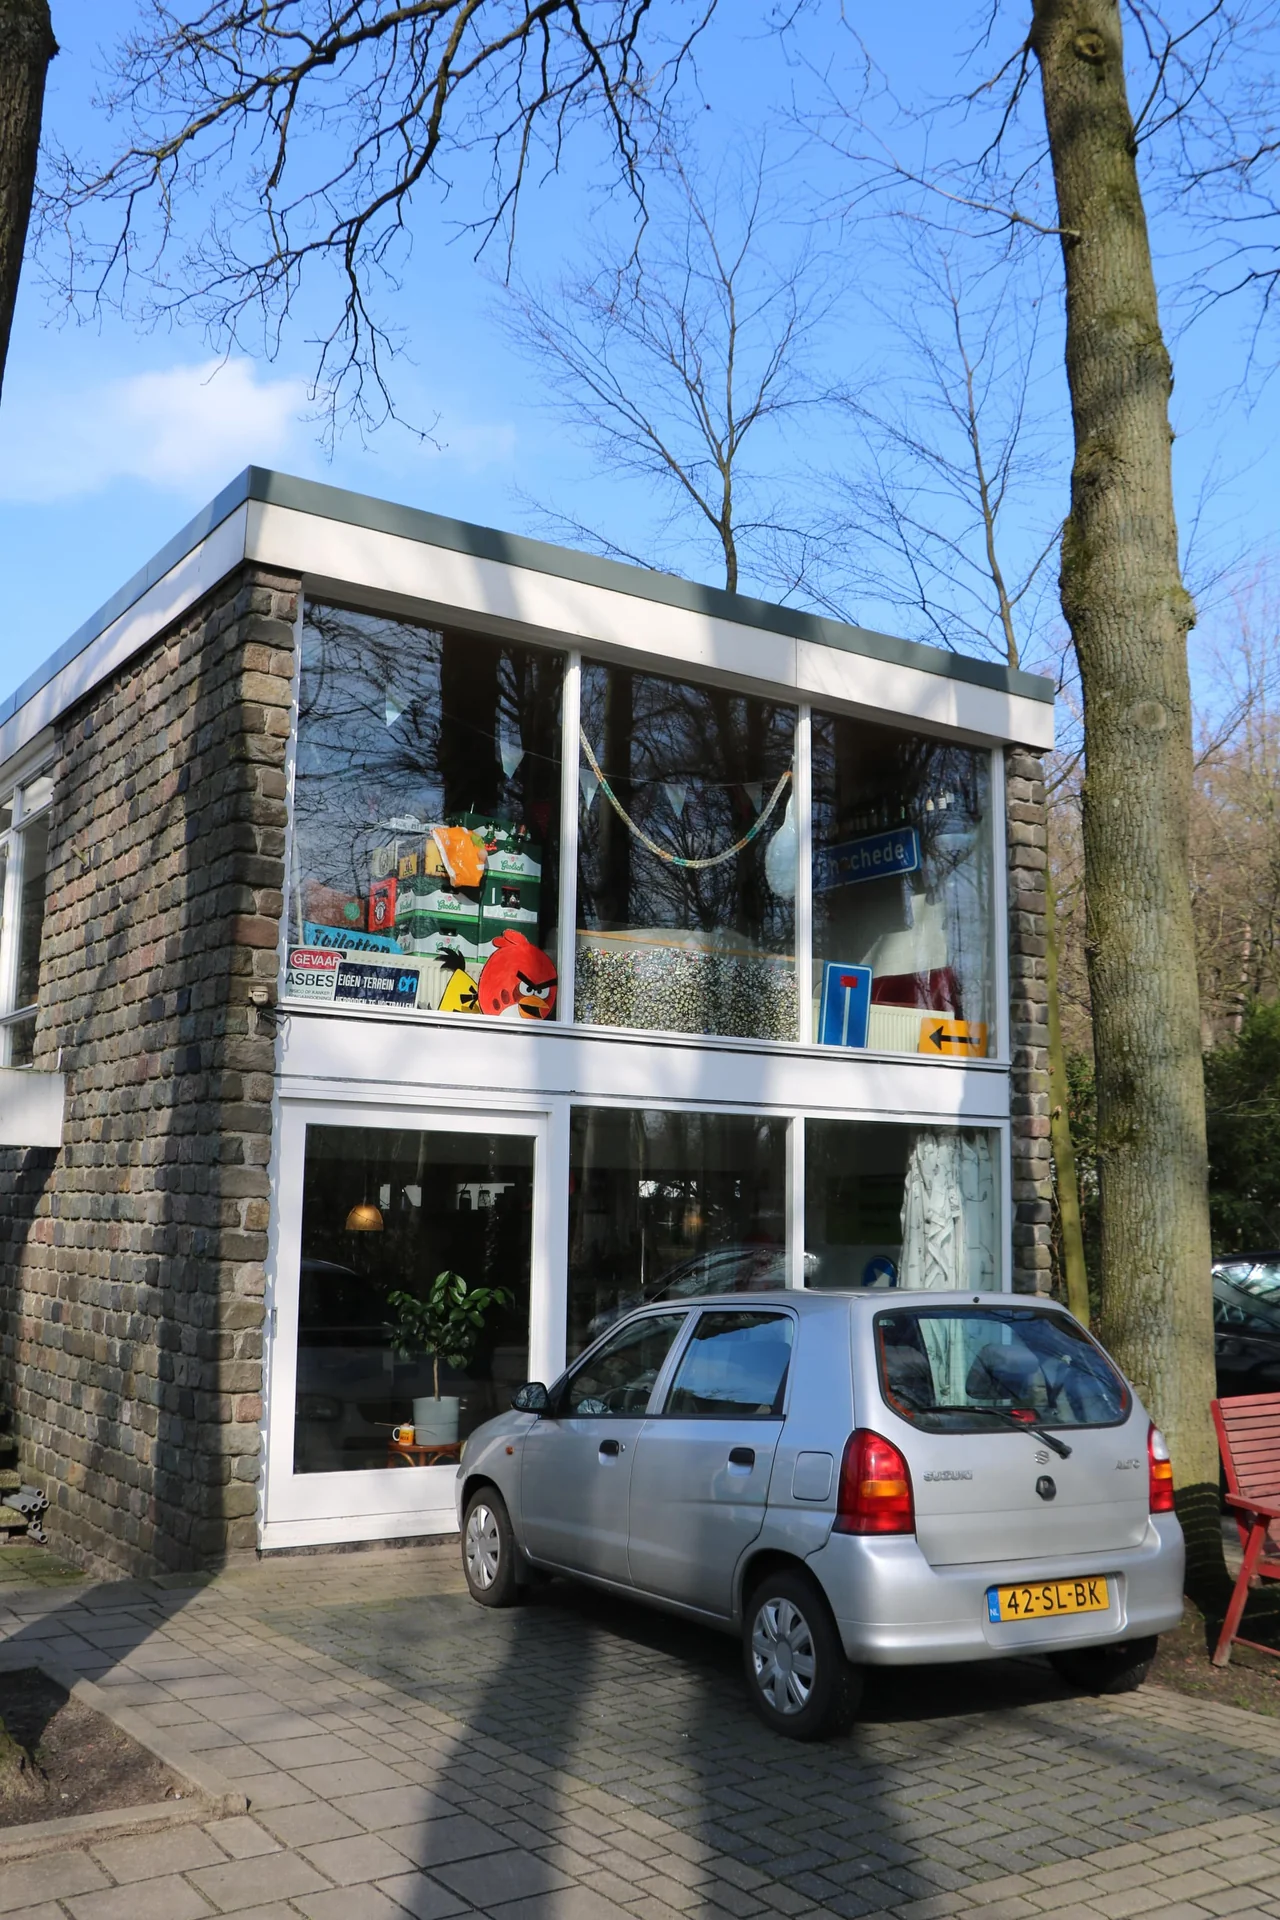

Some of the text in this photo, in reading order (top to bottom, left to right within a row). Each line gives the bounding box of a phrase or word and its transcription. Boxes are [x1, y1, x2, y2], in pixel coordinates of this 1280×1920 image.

[500, 859, 525, 872] Grolsch
[816, 840, 904, 877] nchede
[437, 899, 461, 911] Grolsch
[312, 928, 391, 954] Toiletten
[338, 973, 395, 991] EIGEN TERREIN
[923, 1469, 973, 1482] SUZUKI
[1007, 1580, 1101, 1615] 42-SL-BK
[989, 1607, 999, 1616] NL
